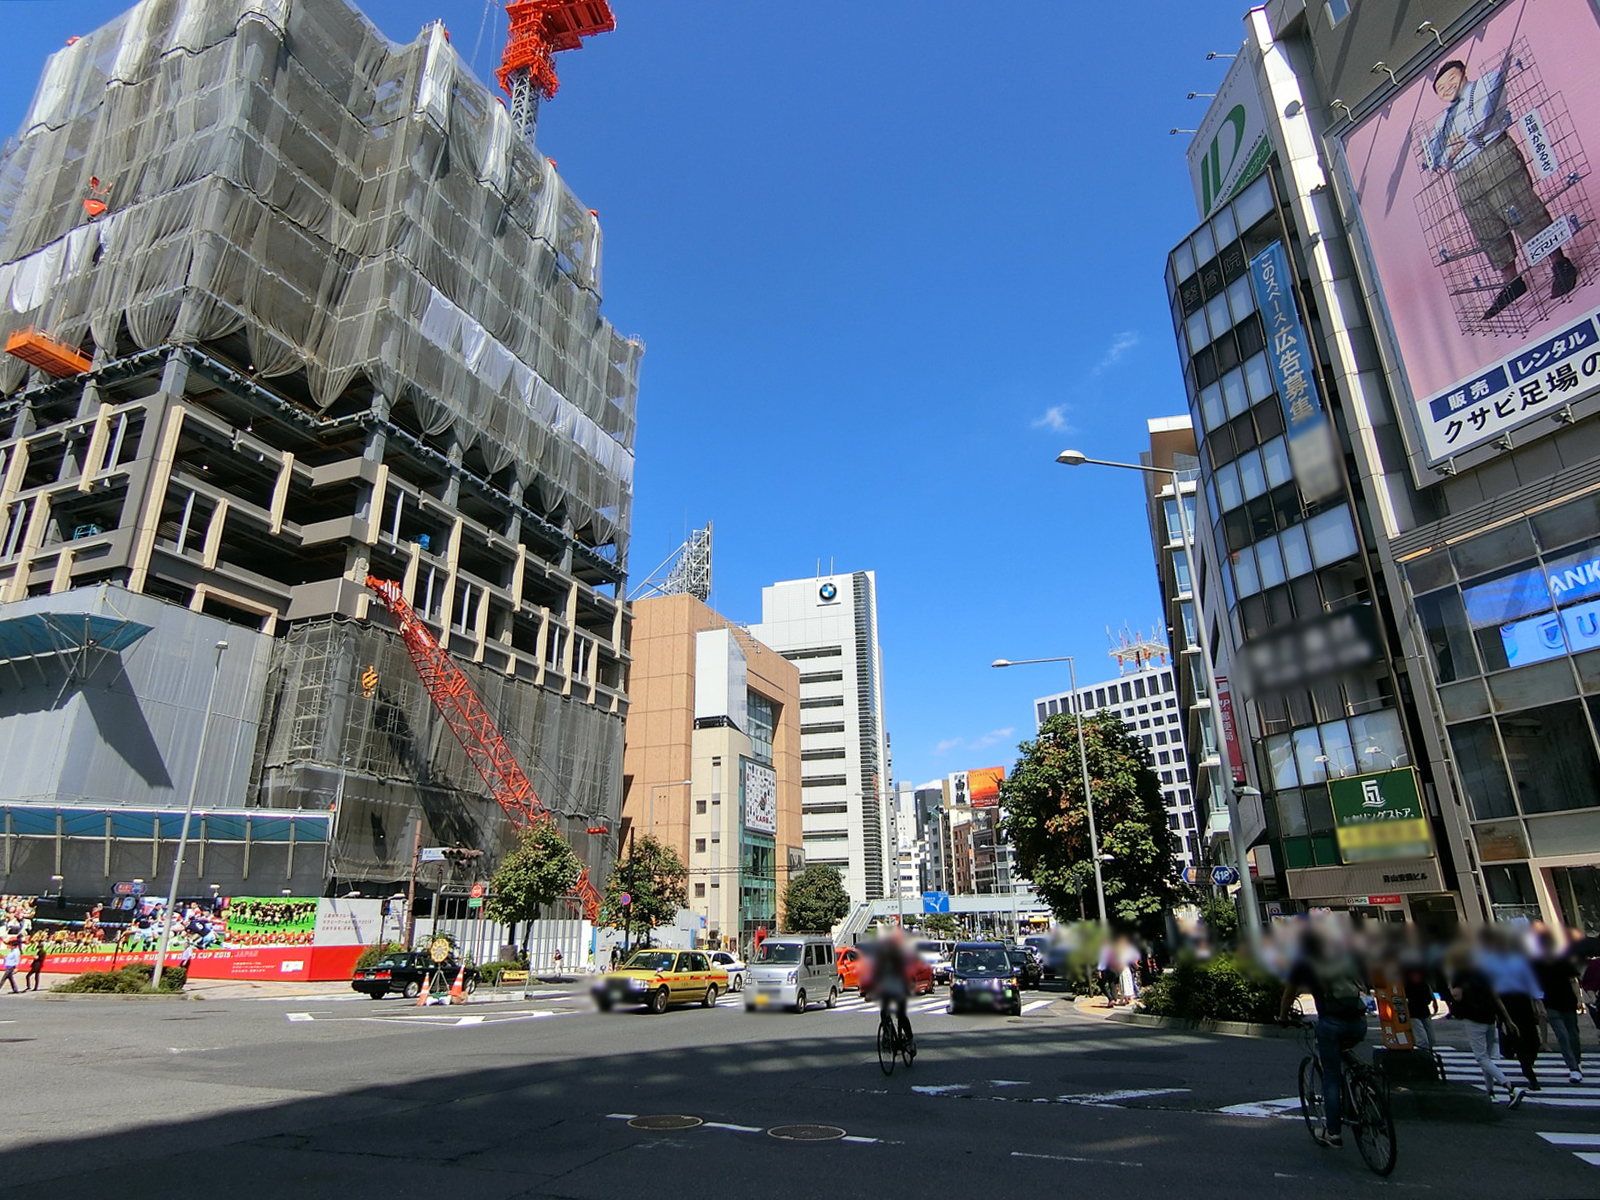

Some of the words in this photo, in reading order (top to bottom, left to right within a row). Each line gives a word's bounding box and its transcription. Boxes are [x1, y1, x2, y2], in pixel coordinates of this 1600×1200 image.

[1184, 251, 1241, 308] 整骨院
[1516, 331, 1588, 375] レンタル
[1444, 351, 1600, 444] クサビ足場の
[1447, 379, 1490, 411] 販売
[1214, 870, 1230, 880] 418
[143, 953, 169, 961] RUGY
[171, 952, 196, 960] WOD
[197, 951, 213, 959] CUP
[234, 950, 259, 958] JAPAN
